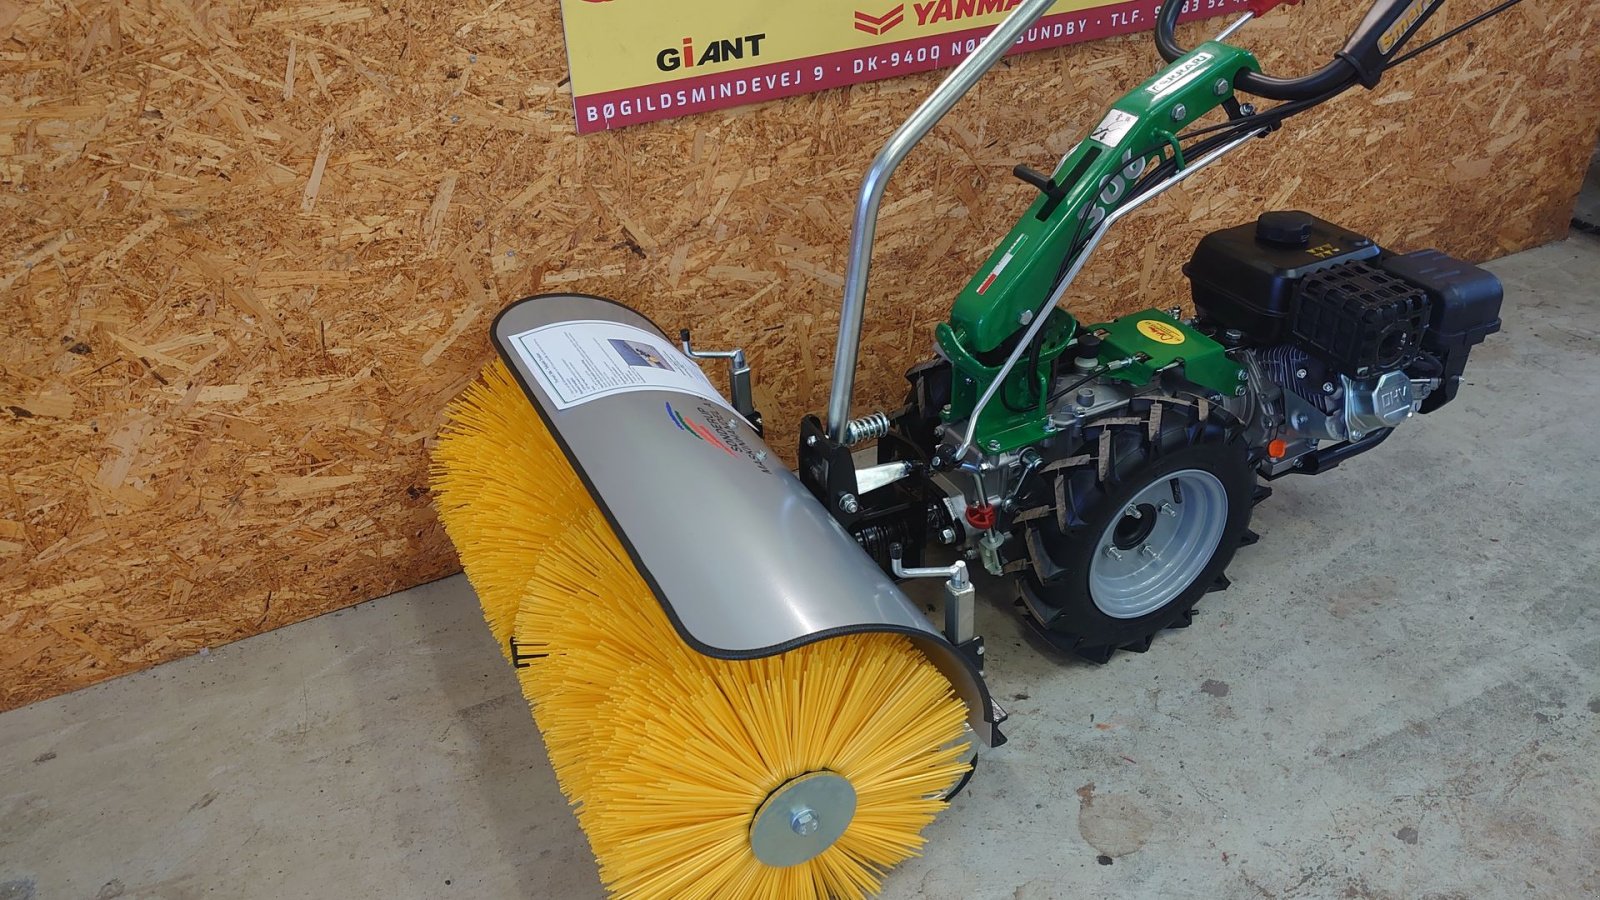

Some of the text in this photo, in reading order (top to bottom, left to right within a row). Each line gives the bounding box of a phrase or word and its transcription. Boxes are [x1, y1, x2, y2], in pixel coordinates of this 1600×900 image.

[914, 0, 1022, 26] YANM
[585, 69, 802, 122] BØGILDSMINDEVEJ
[814, 66, 824, 80] 9
[853, 45, 940, 74] DK-9400
[1111, 10, 1144, 27] TLF.
